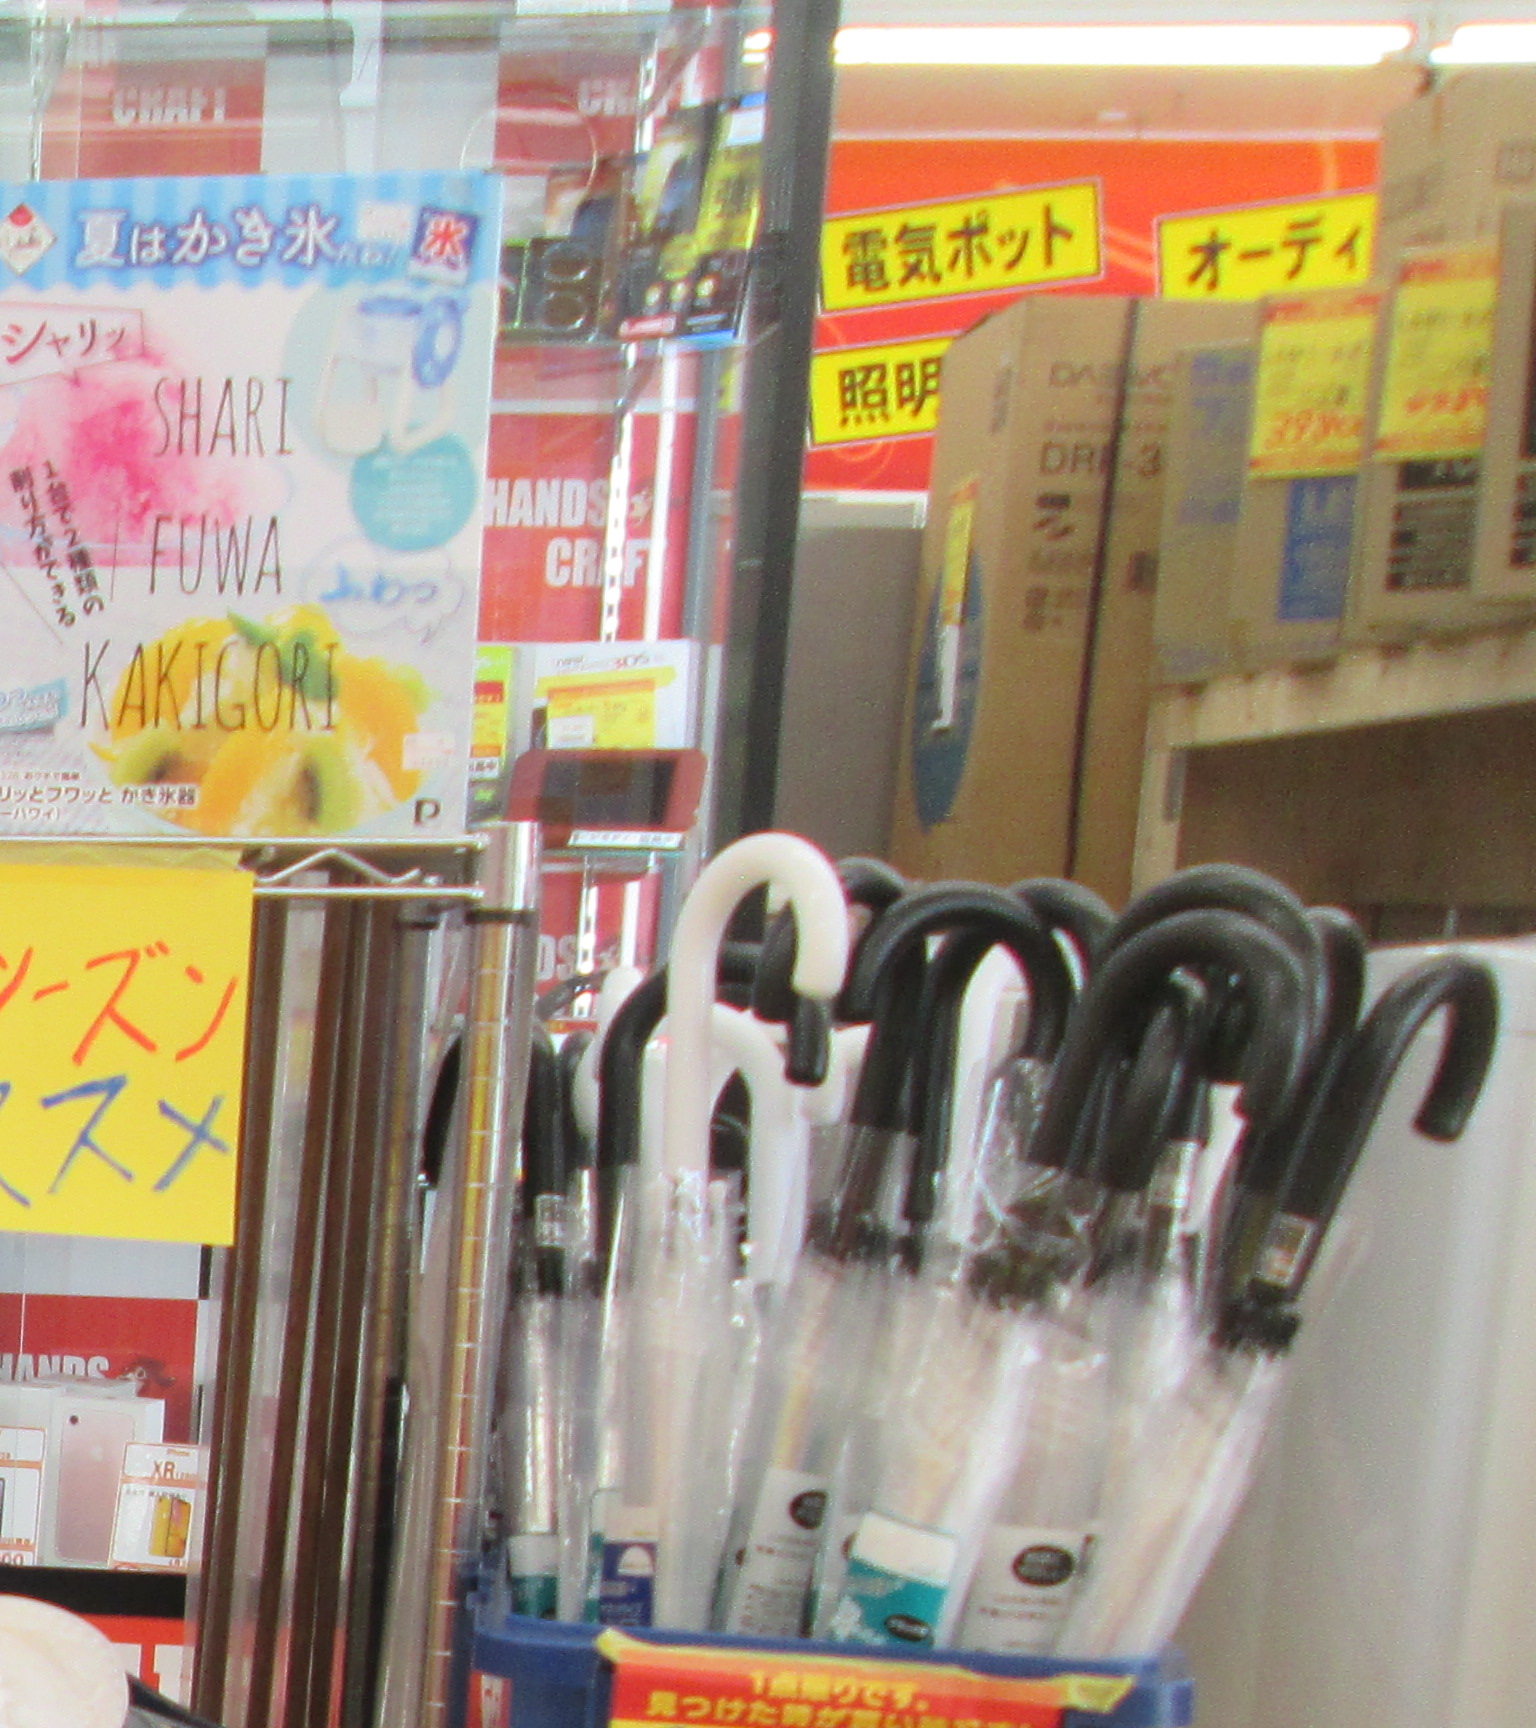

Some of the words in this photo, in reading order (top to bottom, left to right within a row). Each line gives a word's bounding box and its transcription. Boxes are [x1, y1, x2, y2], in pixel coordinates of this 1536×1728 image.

[843, 201, 1074, 293] 電気ポット
[0, 316, 129, 365] シャリッ
[153, 375, 293, 459] SHARI
[148, 515, 284, 598] FUWA
[79, 640, 340, 732] KAKIGORI
[153, 1460, 176, 1480] XR
